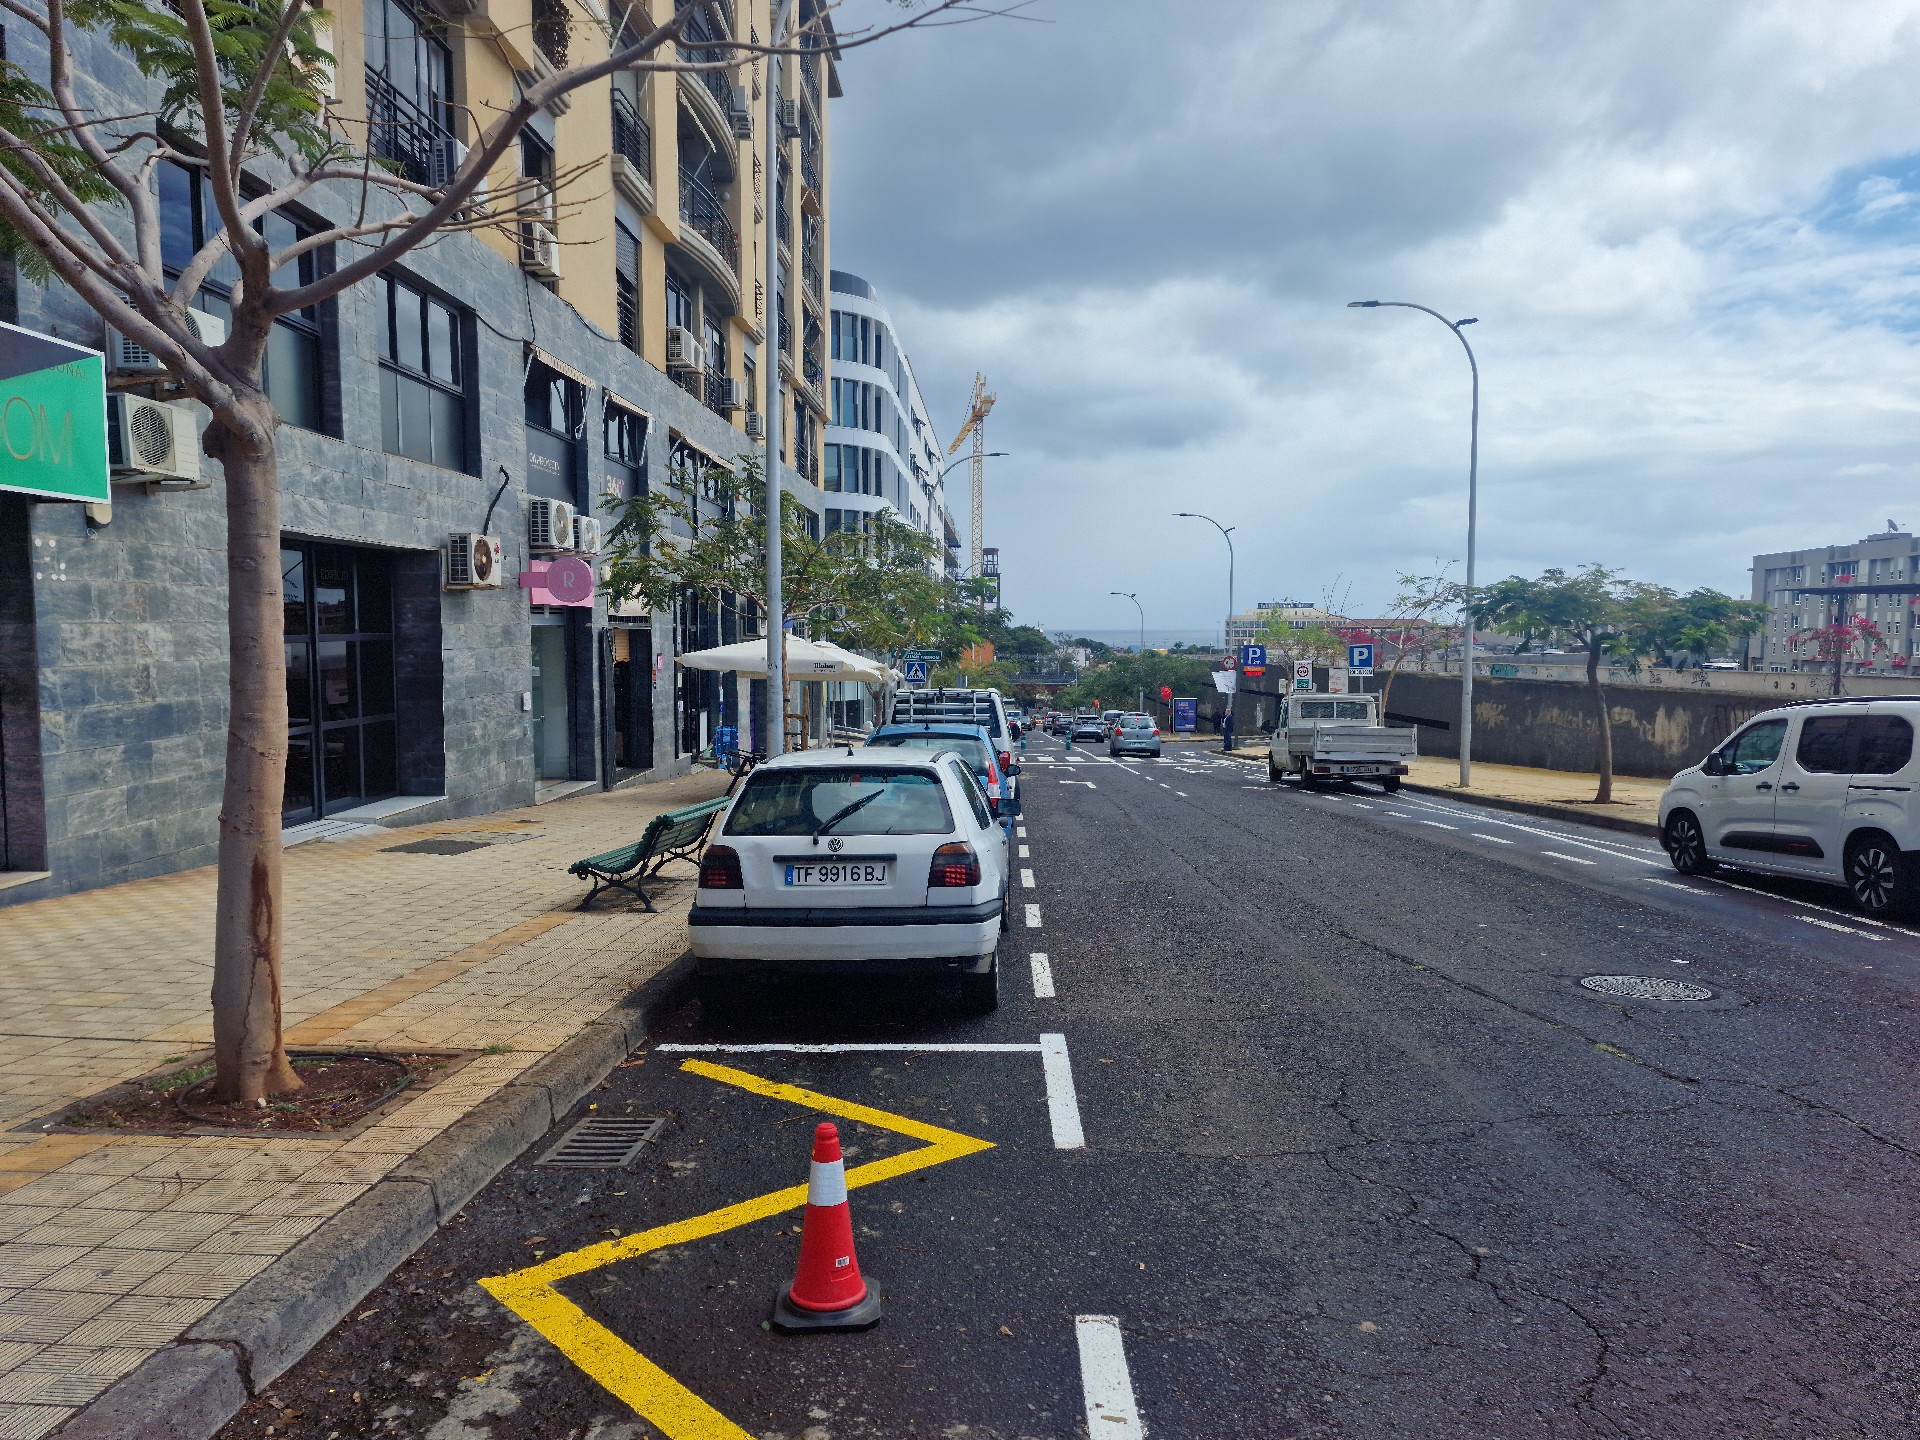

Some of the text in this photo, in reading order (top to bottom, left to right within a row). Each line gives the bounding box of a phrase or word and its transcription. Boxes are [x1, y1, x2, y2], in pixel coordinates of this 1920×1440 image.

[563, 570, 575, 588] R
[1248, 647, 1261, 665] P
[1353, 647, 1369, 666] P
[794, 865, 886, 883] TF 9916 BJ
